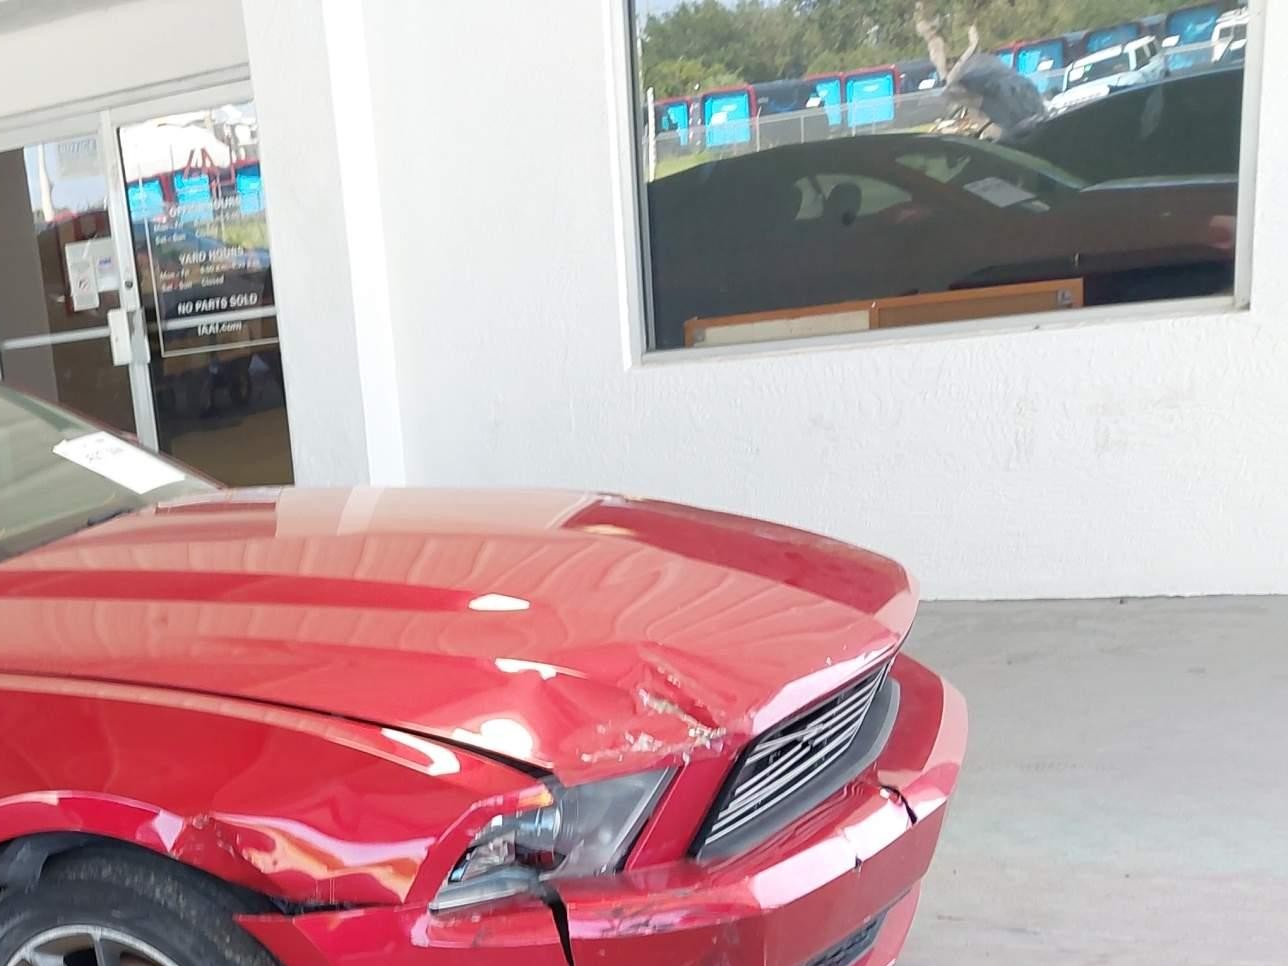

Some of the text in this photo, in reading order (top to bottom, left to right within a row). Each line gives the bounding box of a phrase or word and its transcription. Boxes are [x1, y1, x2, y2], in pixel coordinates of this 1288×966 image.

[179, 250, 207, 265] YARD
[208, 246, 245, 261] HOURS
[177, 292, 258, 315] NO PARTS SOLD
